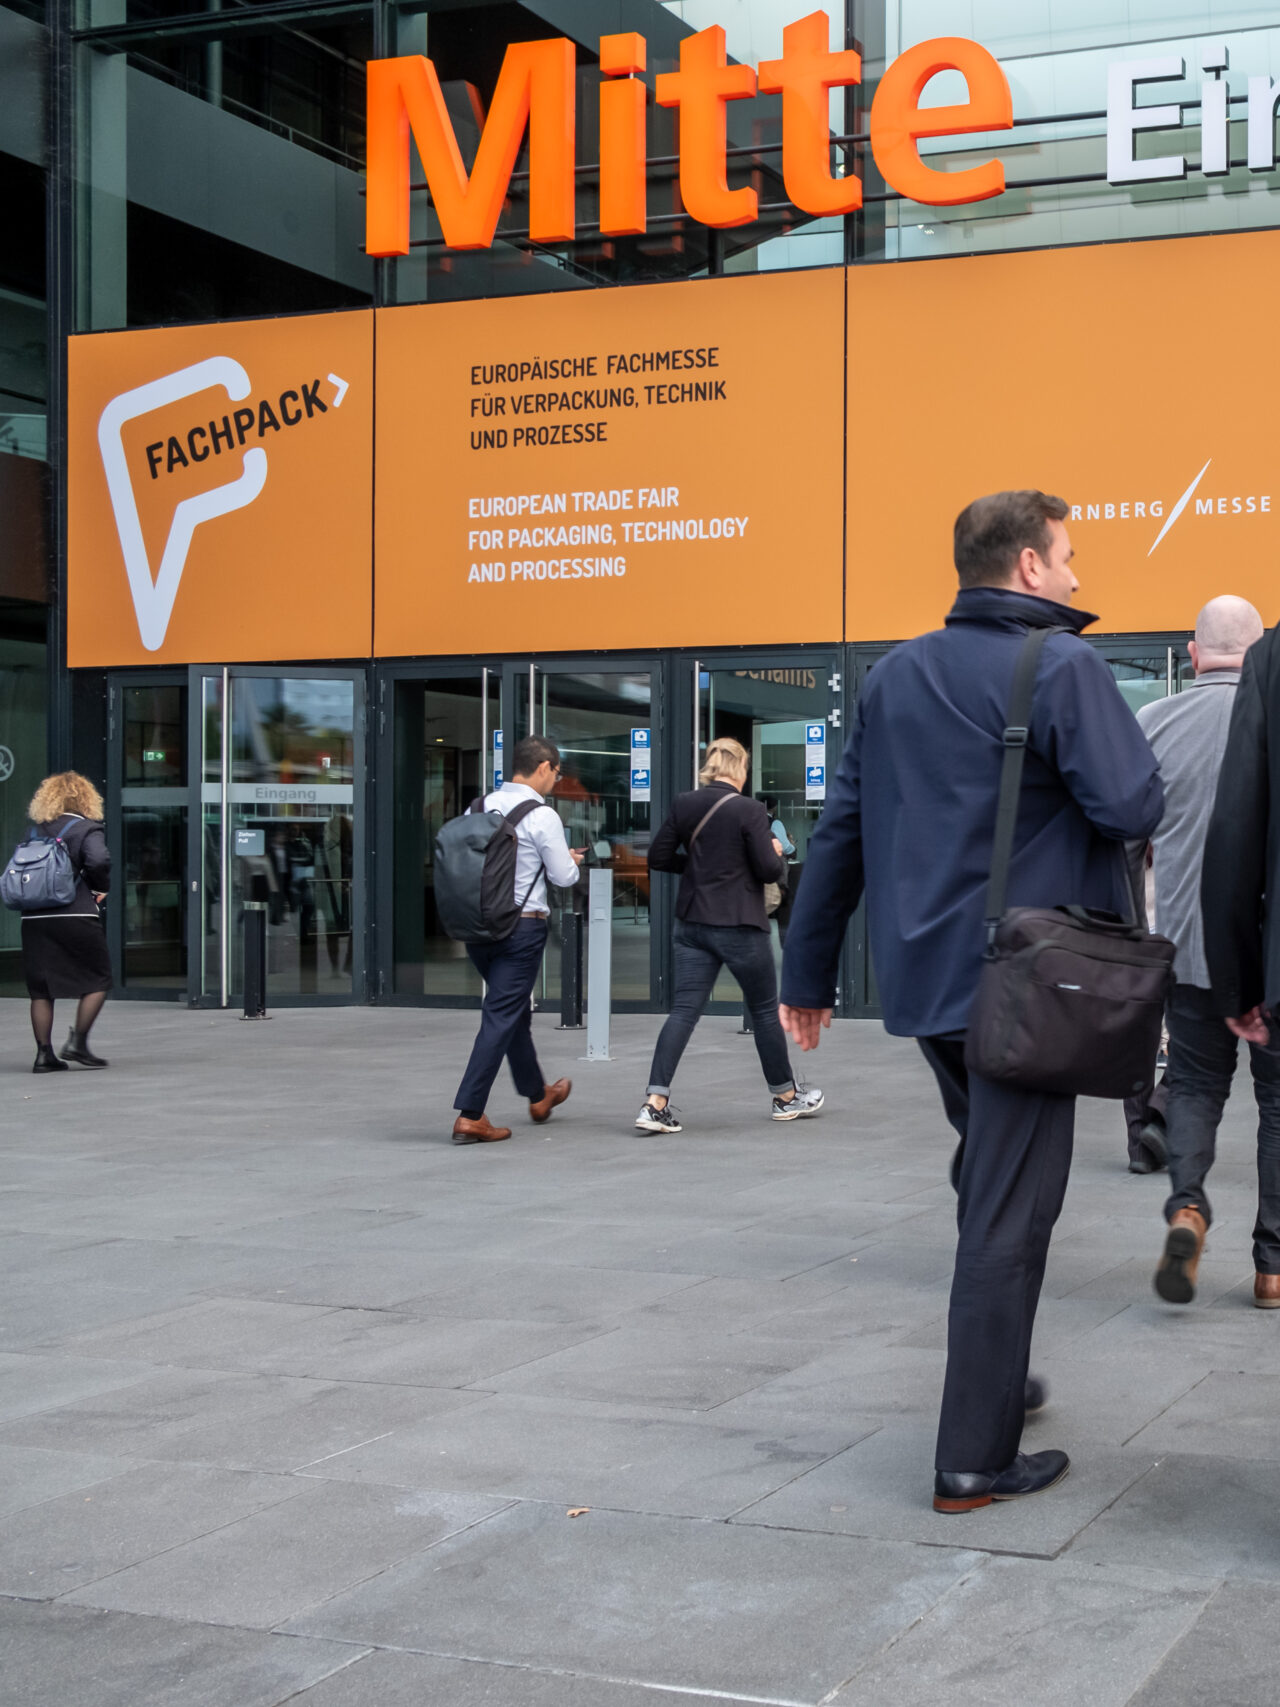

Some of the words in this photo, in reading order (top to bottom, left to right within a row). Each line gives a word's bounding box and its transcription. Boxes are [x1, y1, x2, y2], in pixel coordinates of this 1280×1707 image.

[366, 9, 1014, 258] Mitte
[470, 356, 598, 386] EUROPÄISCHE
[606, 347, 719, 375] FACHMESSE
[470, 392, 506, 418] FÜR
[510, 386, 640, 415] VERPACKUNG,
[644, 380, 727, 405] TECHNIK
[144, 378, 328, 481] FACHPACK
[470, 429, 508, 450] UND
[513, 421, 608, 448] PROZESSE
[468, 493, 567, 518] EUROPEAN
[571, 488, 634, 513] TRADE
[637, 486, 680, 510] FAIR
[1071, 500, 1164, 521] RNBERG
[1195, 495, 1272, 515] MESSE
[468, 529, 504, 551] FOR
[508, 523, 617, 549] PACKAGING,
[621, 516, 749, 543] TECHNOLOGY
[467, 562, 506, 583] AND
[510, 556, 626, 581] PROCESSING
[255, 787, 317, 801] Eingang
